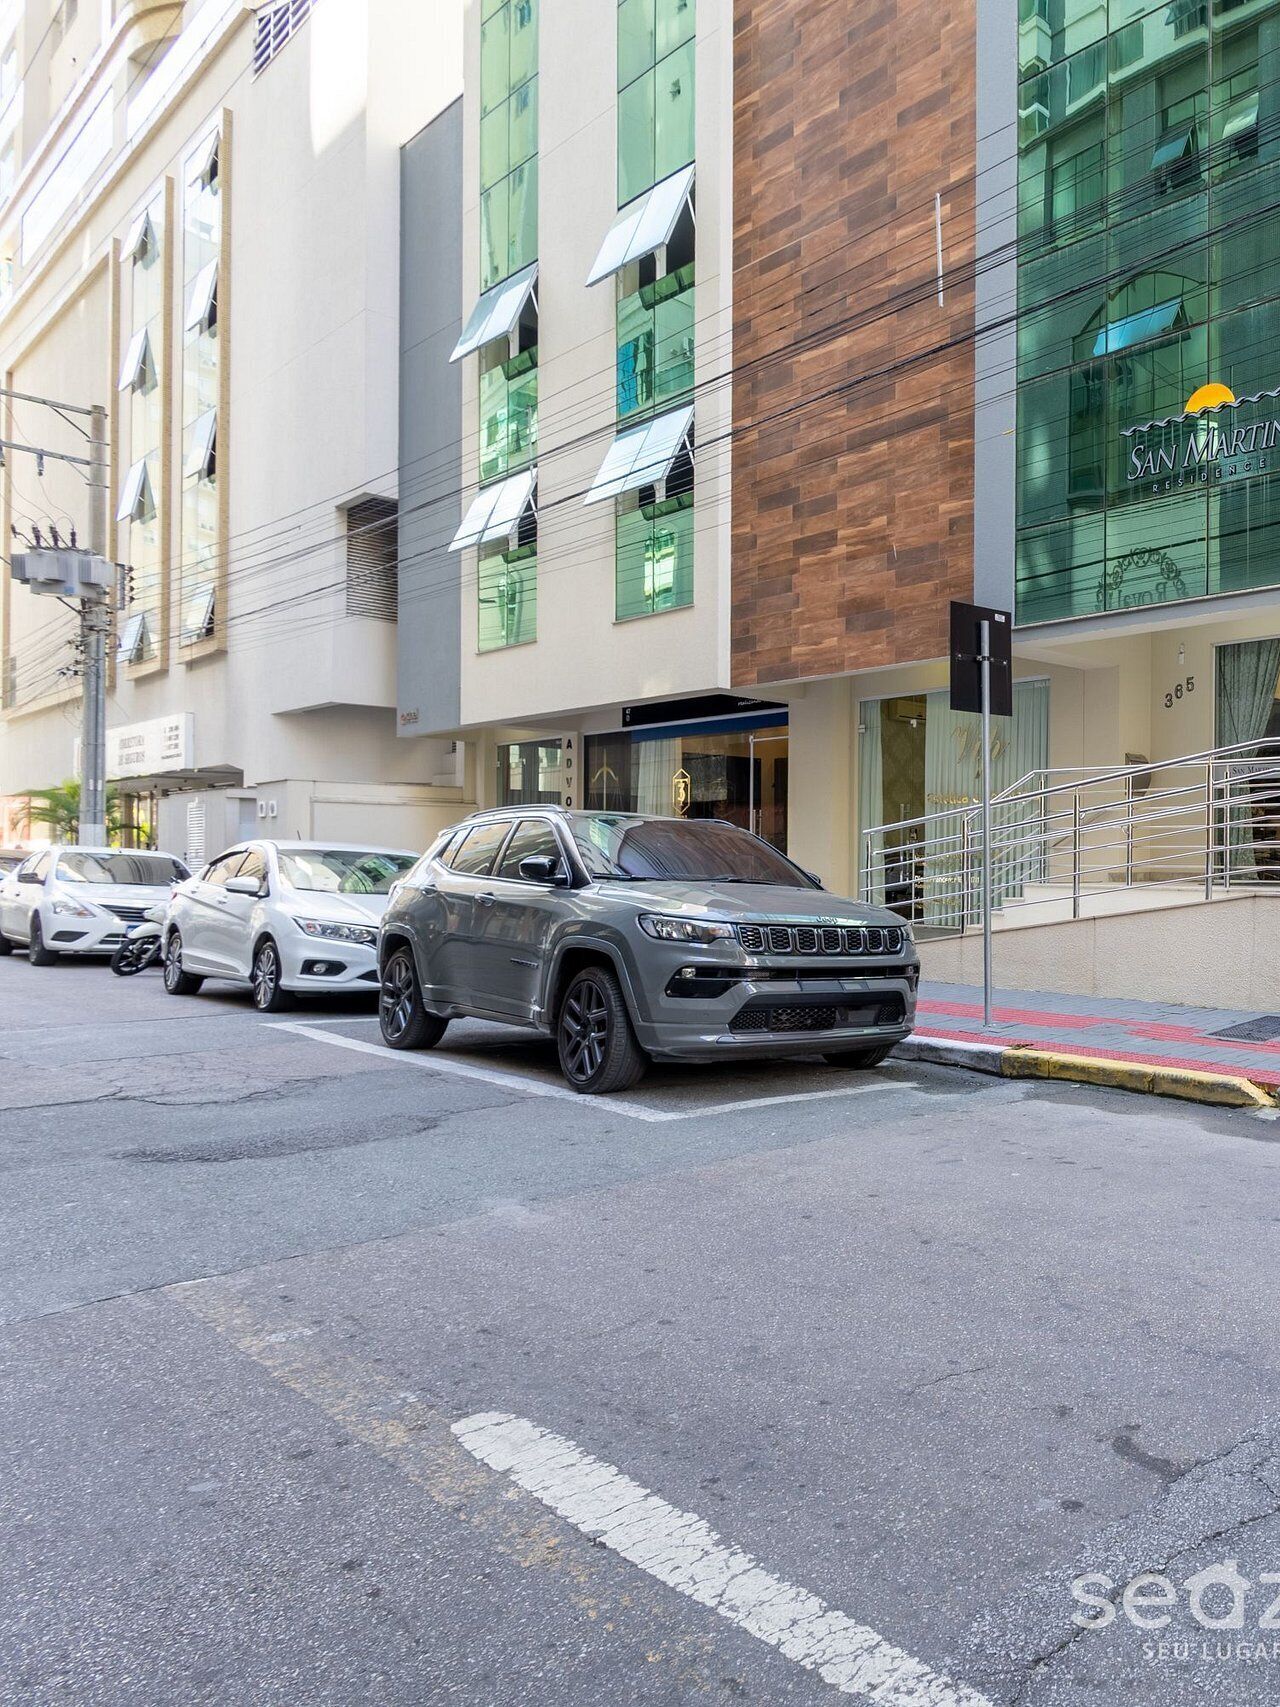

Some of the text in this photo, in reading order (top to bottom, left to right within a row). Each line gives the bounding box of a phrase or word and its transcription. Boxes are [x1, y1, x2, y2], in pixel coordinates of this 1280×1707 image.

[1127, 444, 1177, 480] SAN
[1152, 458, 1267, 493] RESIDENCE
[1164, 676, 1195, 709] 365
